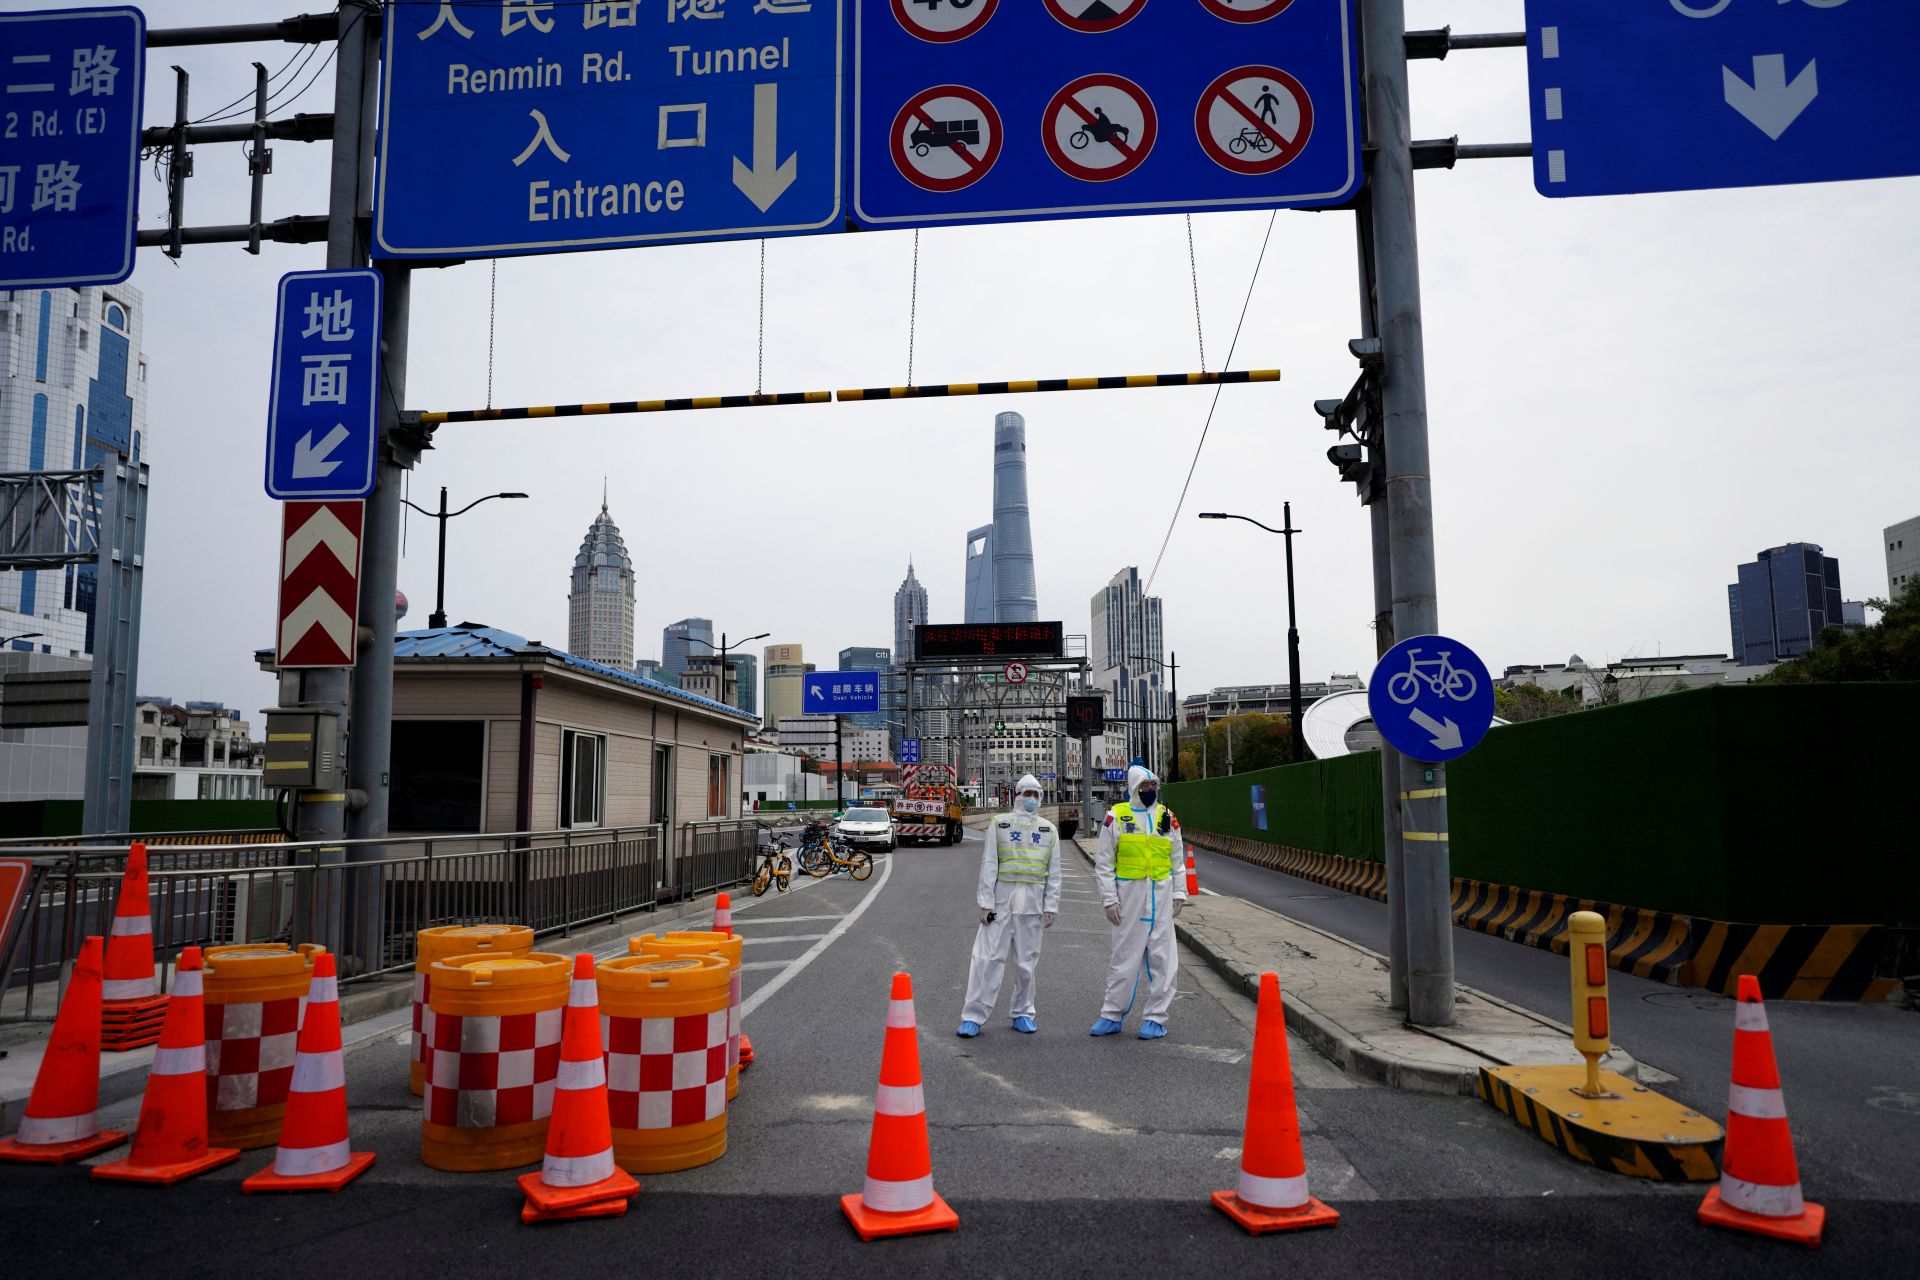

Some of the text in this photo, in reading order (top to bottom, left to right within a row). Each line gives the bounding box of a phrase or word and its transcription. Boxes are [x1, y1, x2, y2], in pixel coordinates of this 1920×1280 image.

[417, 0, 812, 41] 人民路
[448, 37, 790, 95] Renmin Rd. Tunnel
[6, 107, 106, 138] 2 Rd. (E)
[512, 102, 707, 167] 入口
[529, 179, 685, 222] Entrance
[3, 226, 35, 252] Rd.
[301, 289, 354, 406] 地面
[832, 684, 874, 693] 超限车辆
